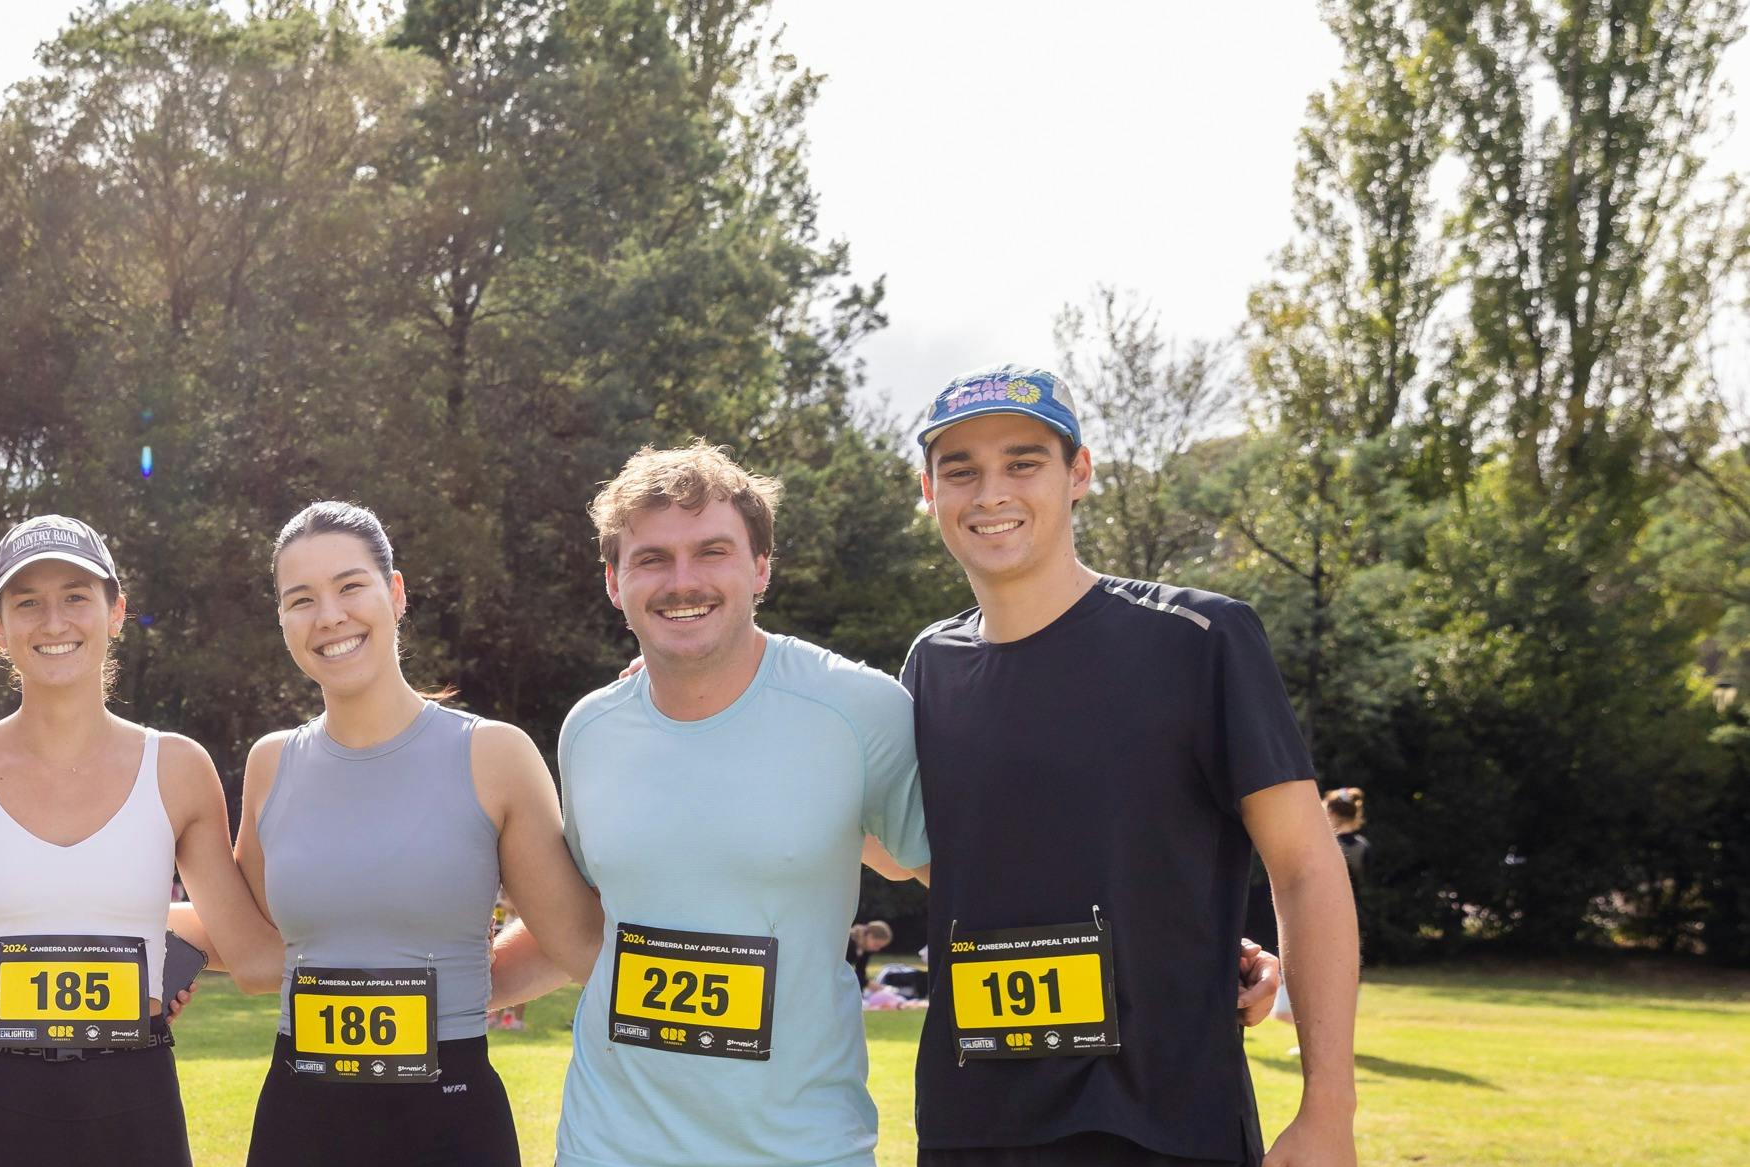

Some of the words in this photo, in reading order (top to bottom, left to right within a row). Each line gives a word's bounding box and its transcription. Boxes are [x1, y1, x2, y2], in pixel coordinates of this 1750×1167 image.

[12, 530, 51, 552] COUNTRY
[53, 529, 79, 545] ROAD
[2, 944, 27, 953] 2024
[623, 933, 645, 945] 2024
[646, 939, 684, 950] CANBERRA
[700, 945, 730, 954] APPEAL
[731, 947, 748, 955] FUN
[749, 948, 766, 956] RUN
[951, 942, 976, 952] 2024
[977, 942, 1014, 951] CANBERRA
[1014, 941, 1030, 949] DAY
[1031, 939, 1062, 947] APPEAL
[30, 971, 110, 1011] 185
[298, 975, 317, 985] 2024
[642, 967, 730, 1017] 225
[982, 968, 1062, 1016] 191
[0, 1029, 34, 1038] ENLIGHTEN
[319, 1005, 397, 1046] 186
[616, 1024, 648, 1038] ENLIGHTEN
